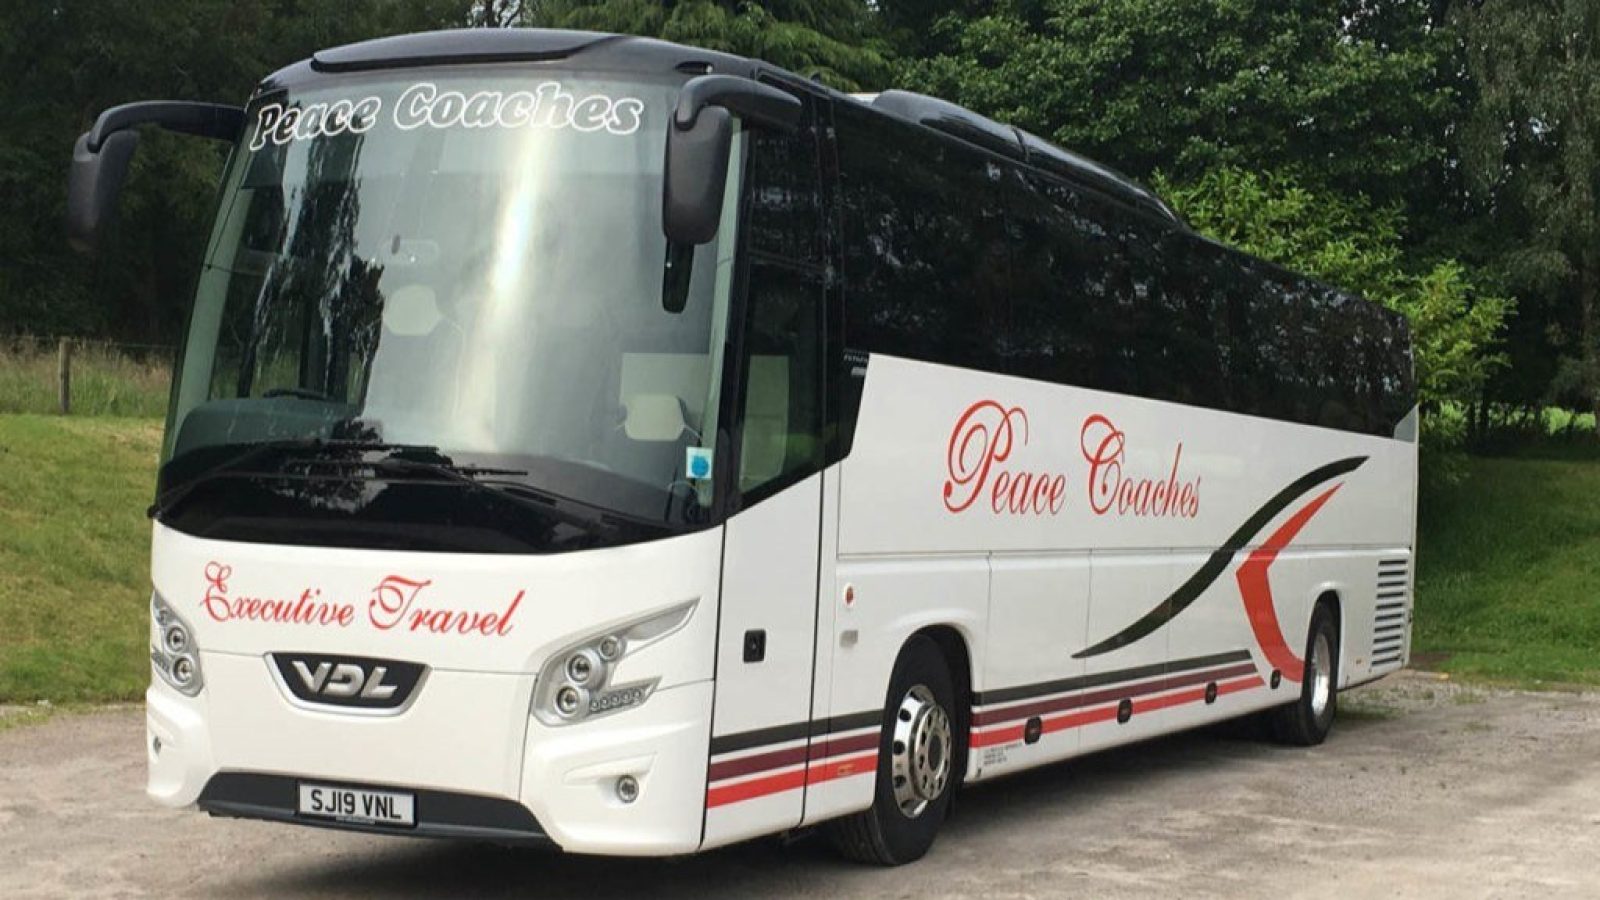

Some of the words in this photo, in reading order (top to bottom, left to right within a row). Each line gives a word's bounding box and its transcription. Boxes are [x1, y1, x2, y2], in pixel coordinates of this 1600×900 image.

[250, 96, 380, 150] Peace
[394, 82, 642, 135] Coaches
[943, 400, 1066, 514] Peace
[1081, 414, 1201, 518] Coaches
[200, 562, 355, 627] Executive
[369, 575, 525, 637] Travel
[292, 660, 398, 697] VDL
[310, 788, 356, 814] SJ19
[362, 794, 402, 819] VNL
